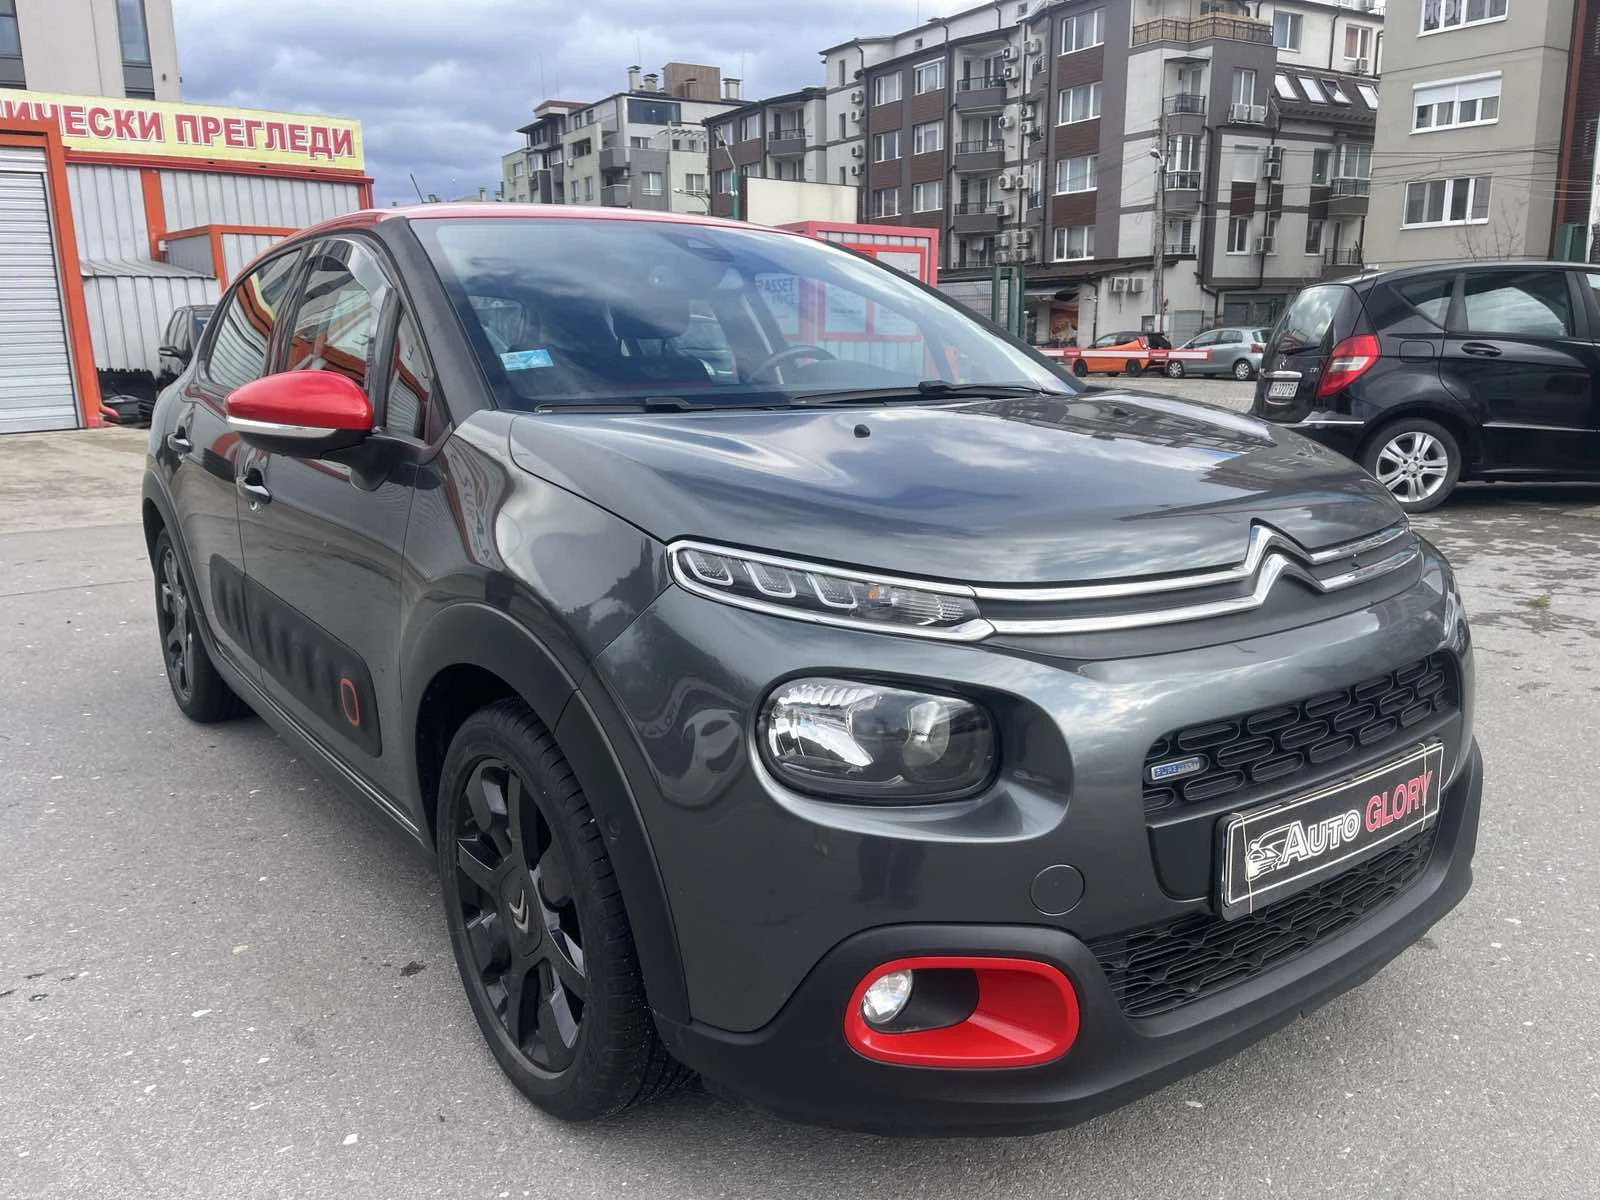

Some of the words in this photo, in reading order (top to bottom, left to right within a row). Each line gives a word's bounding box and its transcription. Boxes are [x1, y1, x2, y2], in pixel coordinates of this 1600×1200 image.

[175, 113, 355, 159] ПРЕГЛЕДИ
[1278, 810, 1361, 867] AUTO
[1365, 770, 1433, 832] GLORY
